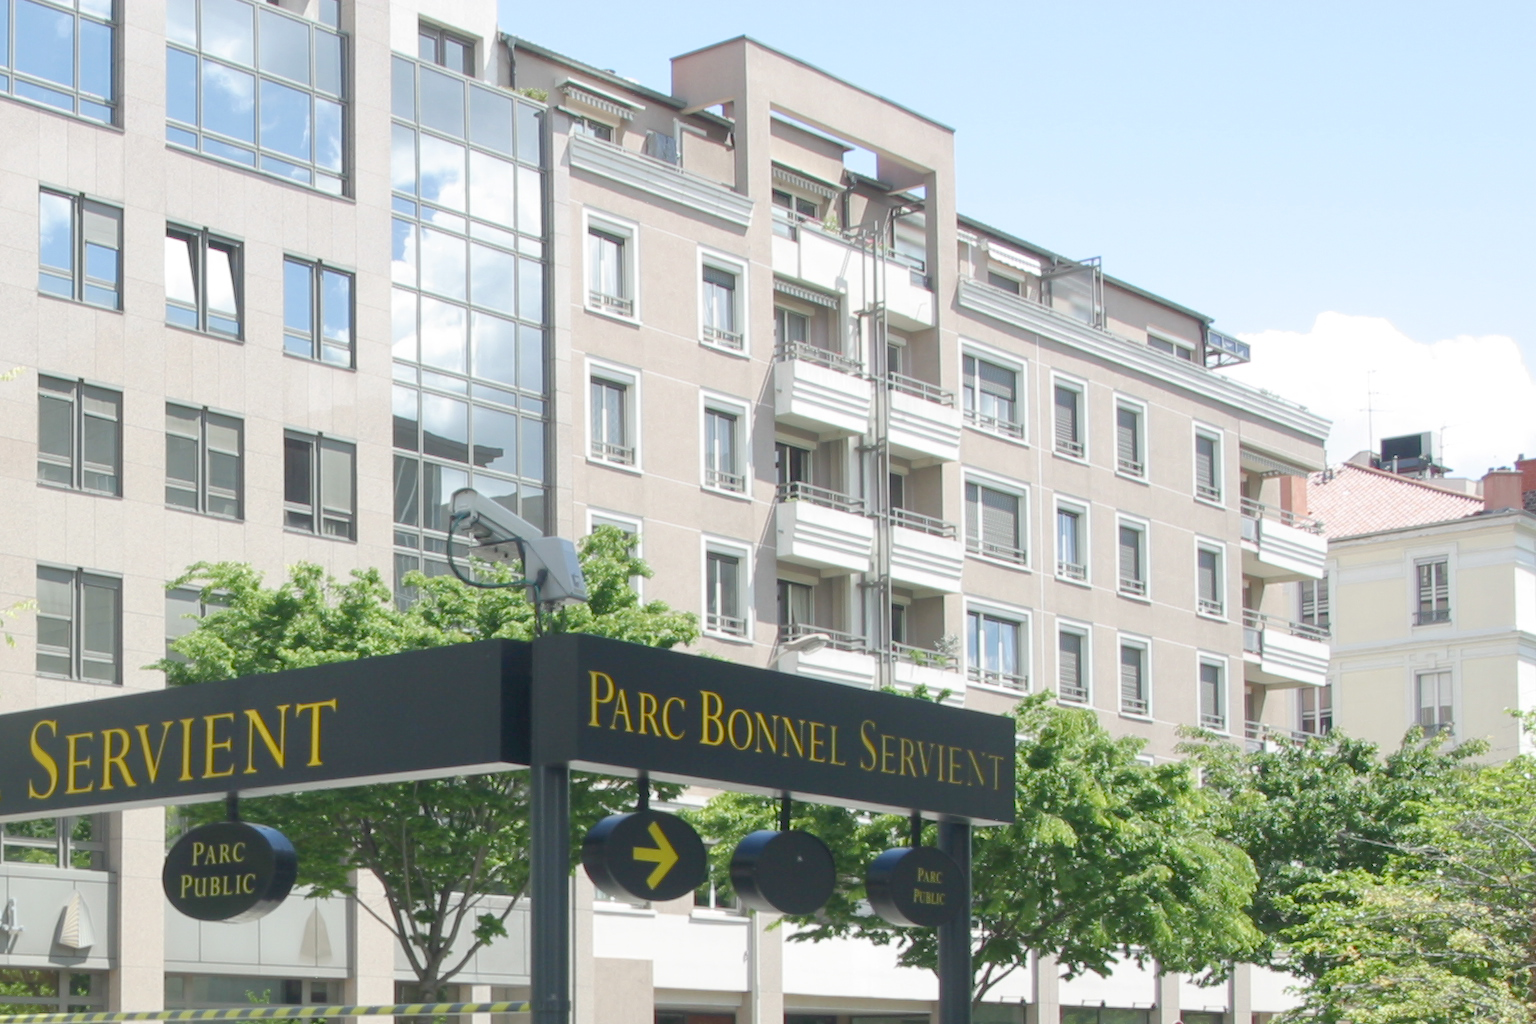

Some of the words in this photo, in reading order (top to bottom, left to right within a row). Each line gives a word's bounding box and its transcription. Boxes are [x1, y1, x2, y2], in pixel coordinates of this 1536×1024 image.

[587, 669, 687, 742] PARC
[699, 689, 846, 767] BONNEL
[859, 719, 1004, 791] SERVIENT
[26, 698, 338, 800] SERVIENT
[192, 841, 246, 867] PARC
[180, 872, 257, 899] PUBLIC
[917, 867, 943, 884] PARC
[913, 888, 946, 906] PUBLIC
